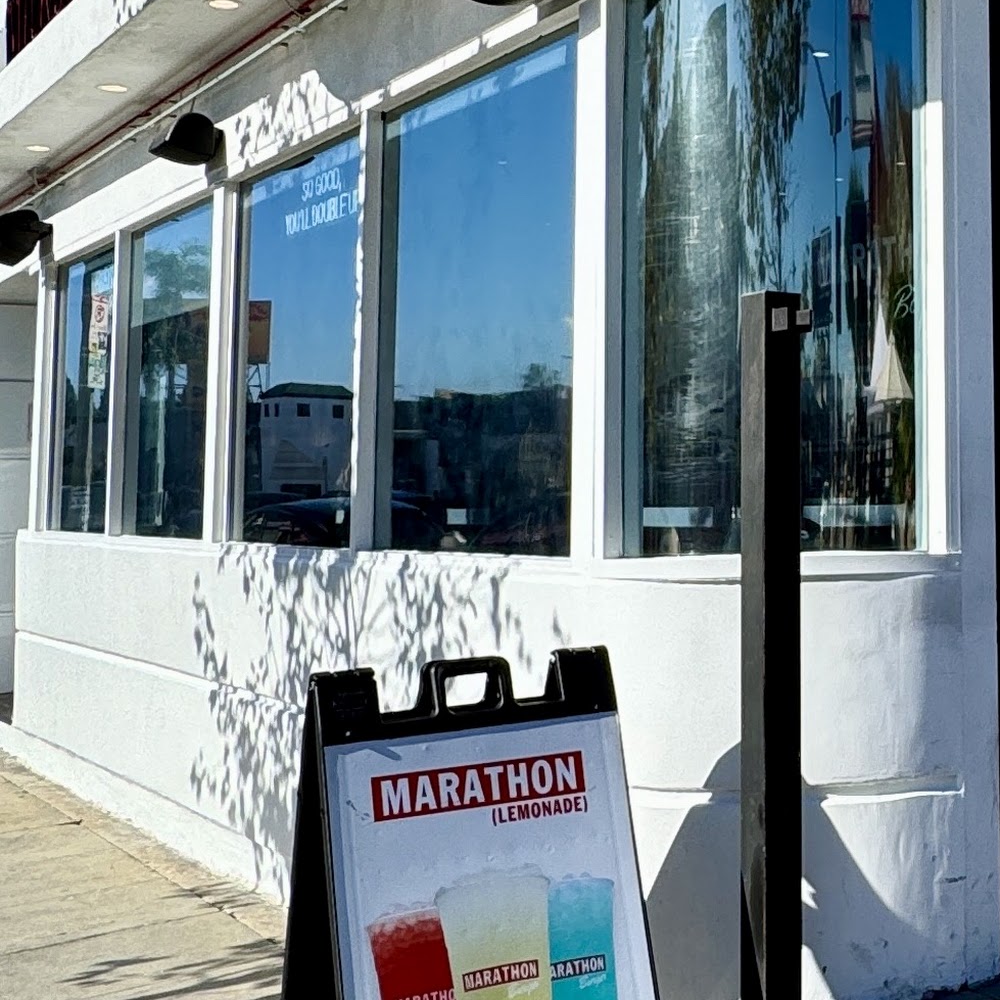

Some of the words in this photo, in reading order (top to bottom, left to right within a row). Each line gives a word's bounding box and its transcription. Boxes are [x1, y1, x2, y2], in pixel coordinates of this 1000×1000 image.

[312, 192, 348, 227] DOUBLE
[380, 756, 578, 817] MARATHON
[491, 796, 588, 826] (LEMONADE)
[464, 961, 538, 990] MARATHON
